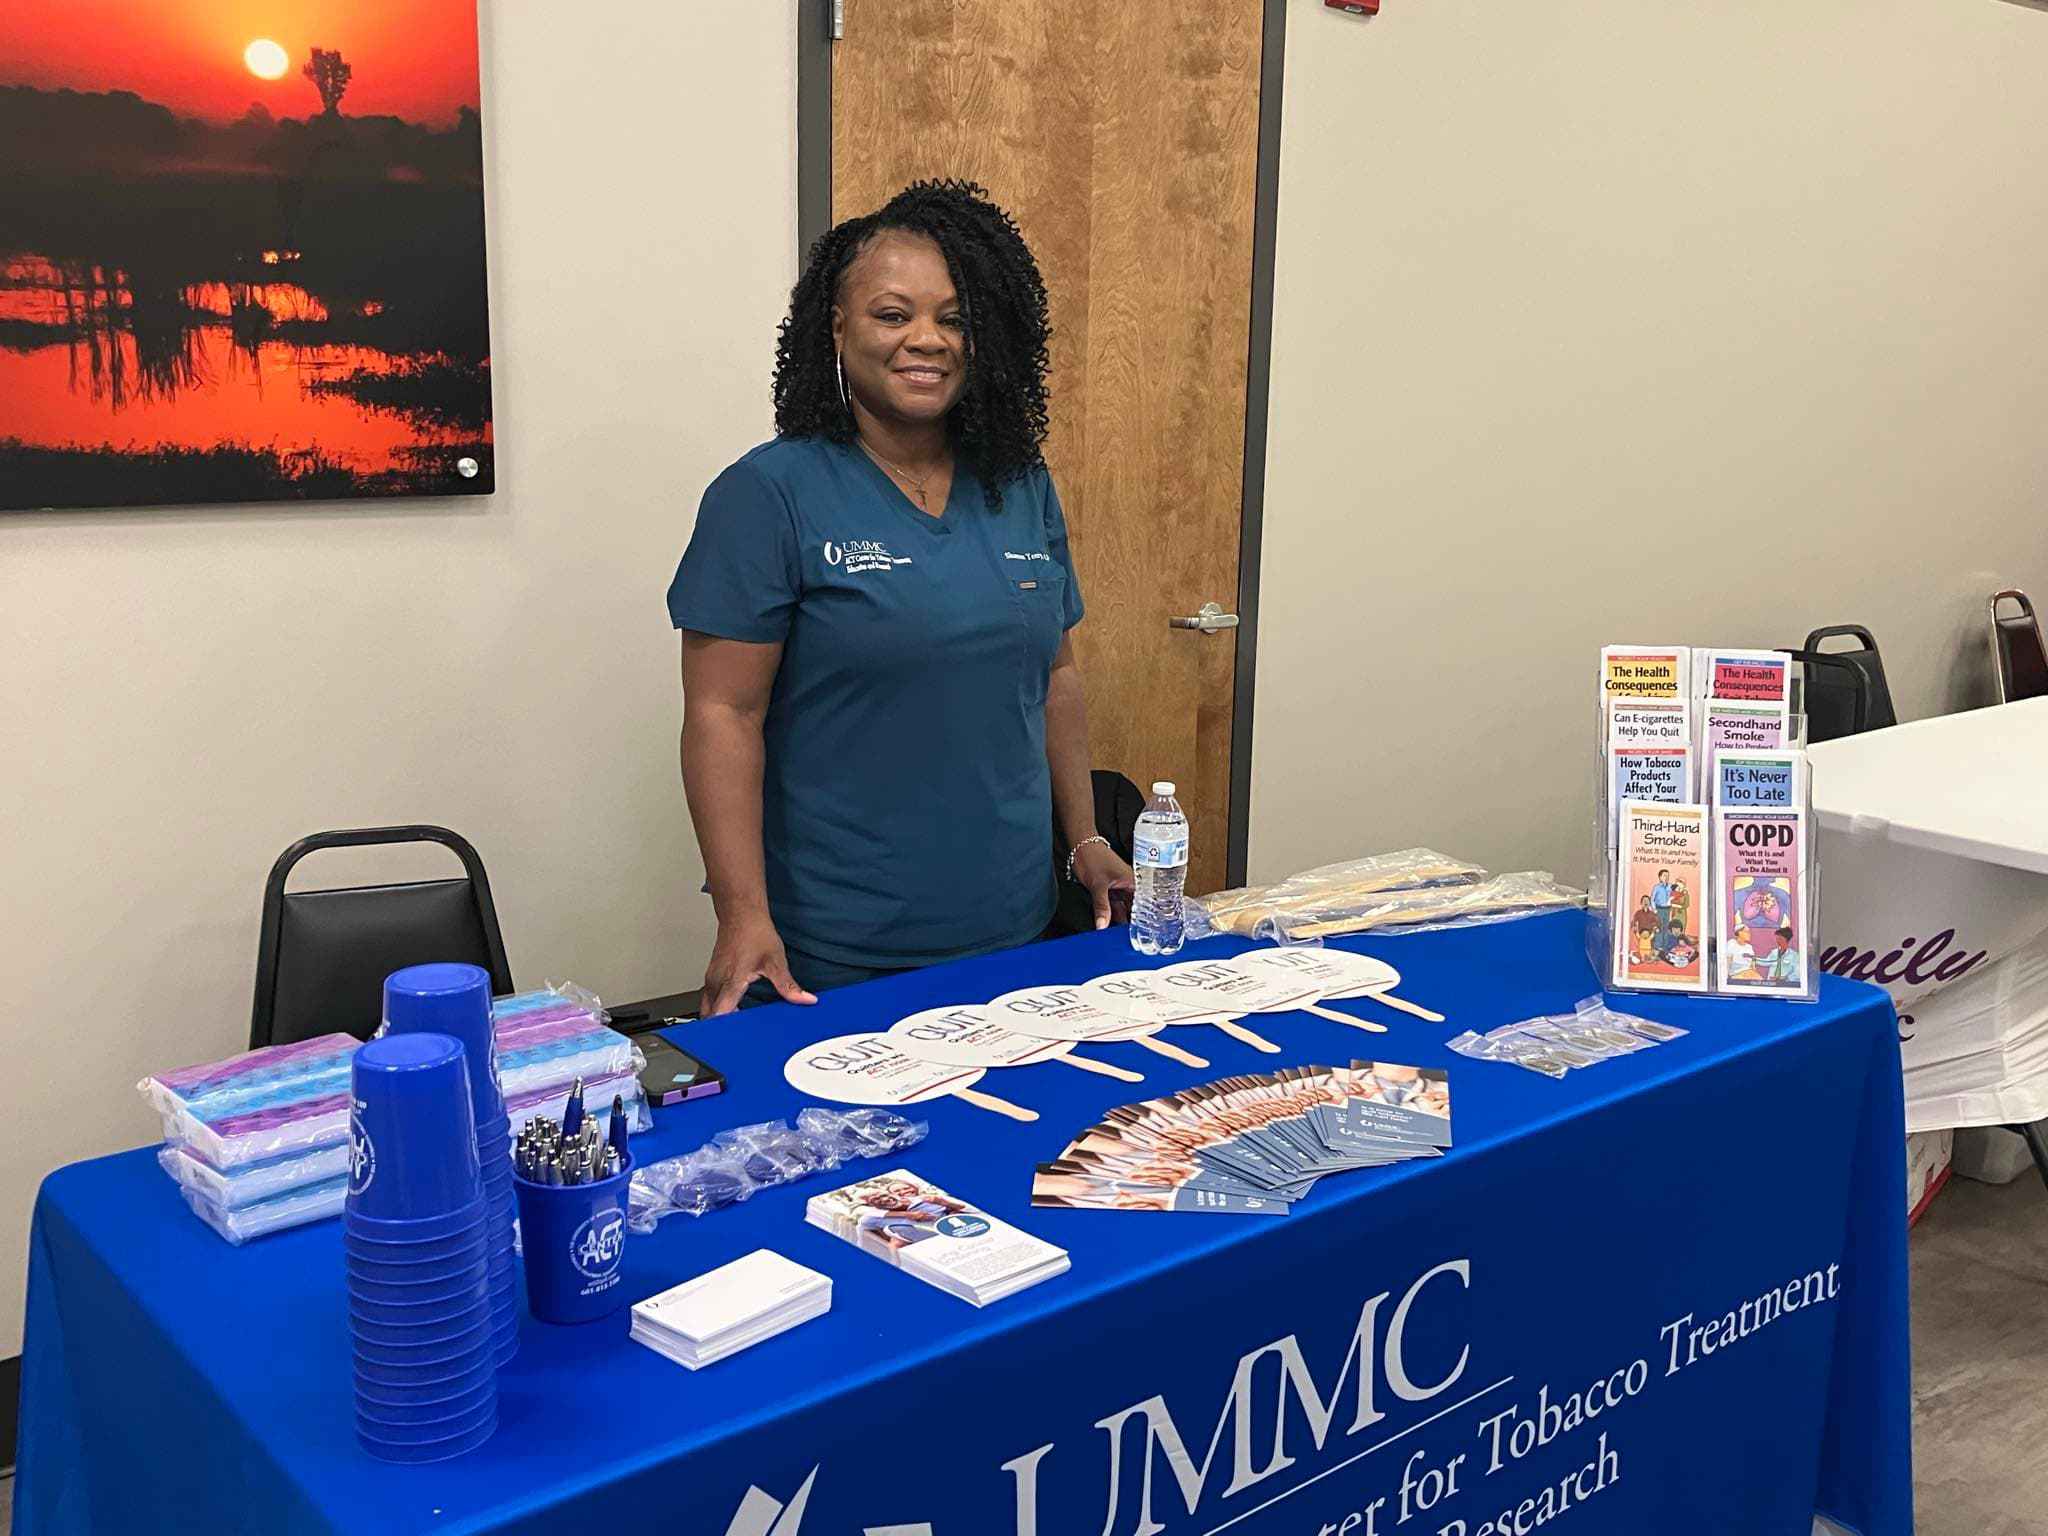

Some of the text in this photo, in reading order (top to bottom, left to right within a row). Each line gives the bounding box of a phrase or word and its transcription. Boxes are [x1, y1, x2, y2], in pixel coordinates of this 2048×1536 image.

[842, 541, 887, 552] UMMC
[1612, 666, 1670, 677] The Health
[1721, 668, 1776, 680] The Health
[1605, 680, 1678, 693] Consequences
[1713, 679, 1784, 692] Consequences
[1614, 713, 1684, 725] Can E-cigarettes
[1708, 717, 1782, 730] Secondhand
[1618, 726, 1680, 737] Help You Quit
[1723, 730, 1765, 741] Smoke
[1714, 741, 1734, 749] How
[1620, 757, 1682, 768] How Tobacco
[1630, 769, 1671, 781] Products
[1725, 768, 1788, 783] It's Never
[1624, 782, 1677, 793] Affect Your
[1727, 785, 1785, 801] Too Late
[1632, 818, 1700, 834] Third-Hand
[1644, 833, 1688, 846] Smoke
[1729, 823, 1794, 848] COPD
[1820, 929, 1988, 984] mily
[1165, 964, 1238, 986] QUIT
[1005, 989, 1079, 1013] QUIT
[907, 1010, 985, 1040] QUIT
[808, 1038, 894, 1070] QUIT
[1001, 1259, 1470, 1536] UMMC
[1396, 1449, 1465, 1525] for
[1478, 1357, 1648, 1476] Tobacco
[1660, 1262, 1840, 1377] Treatment
